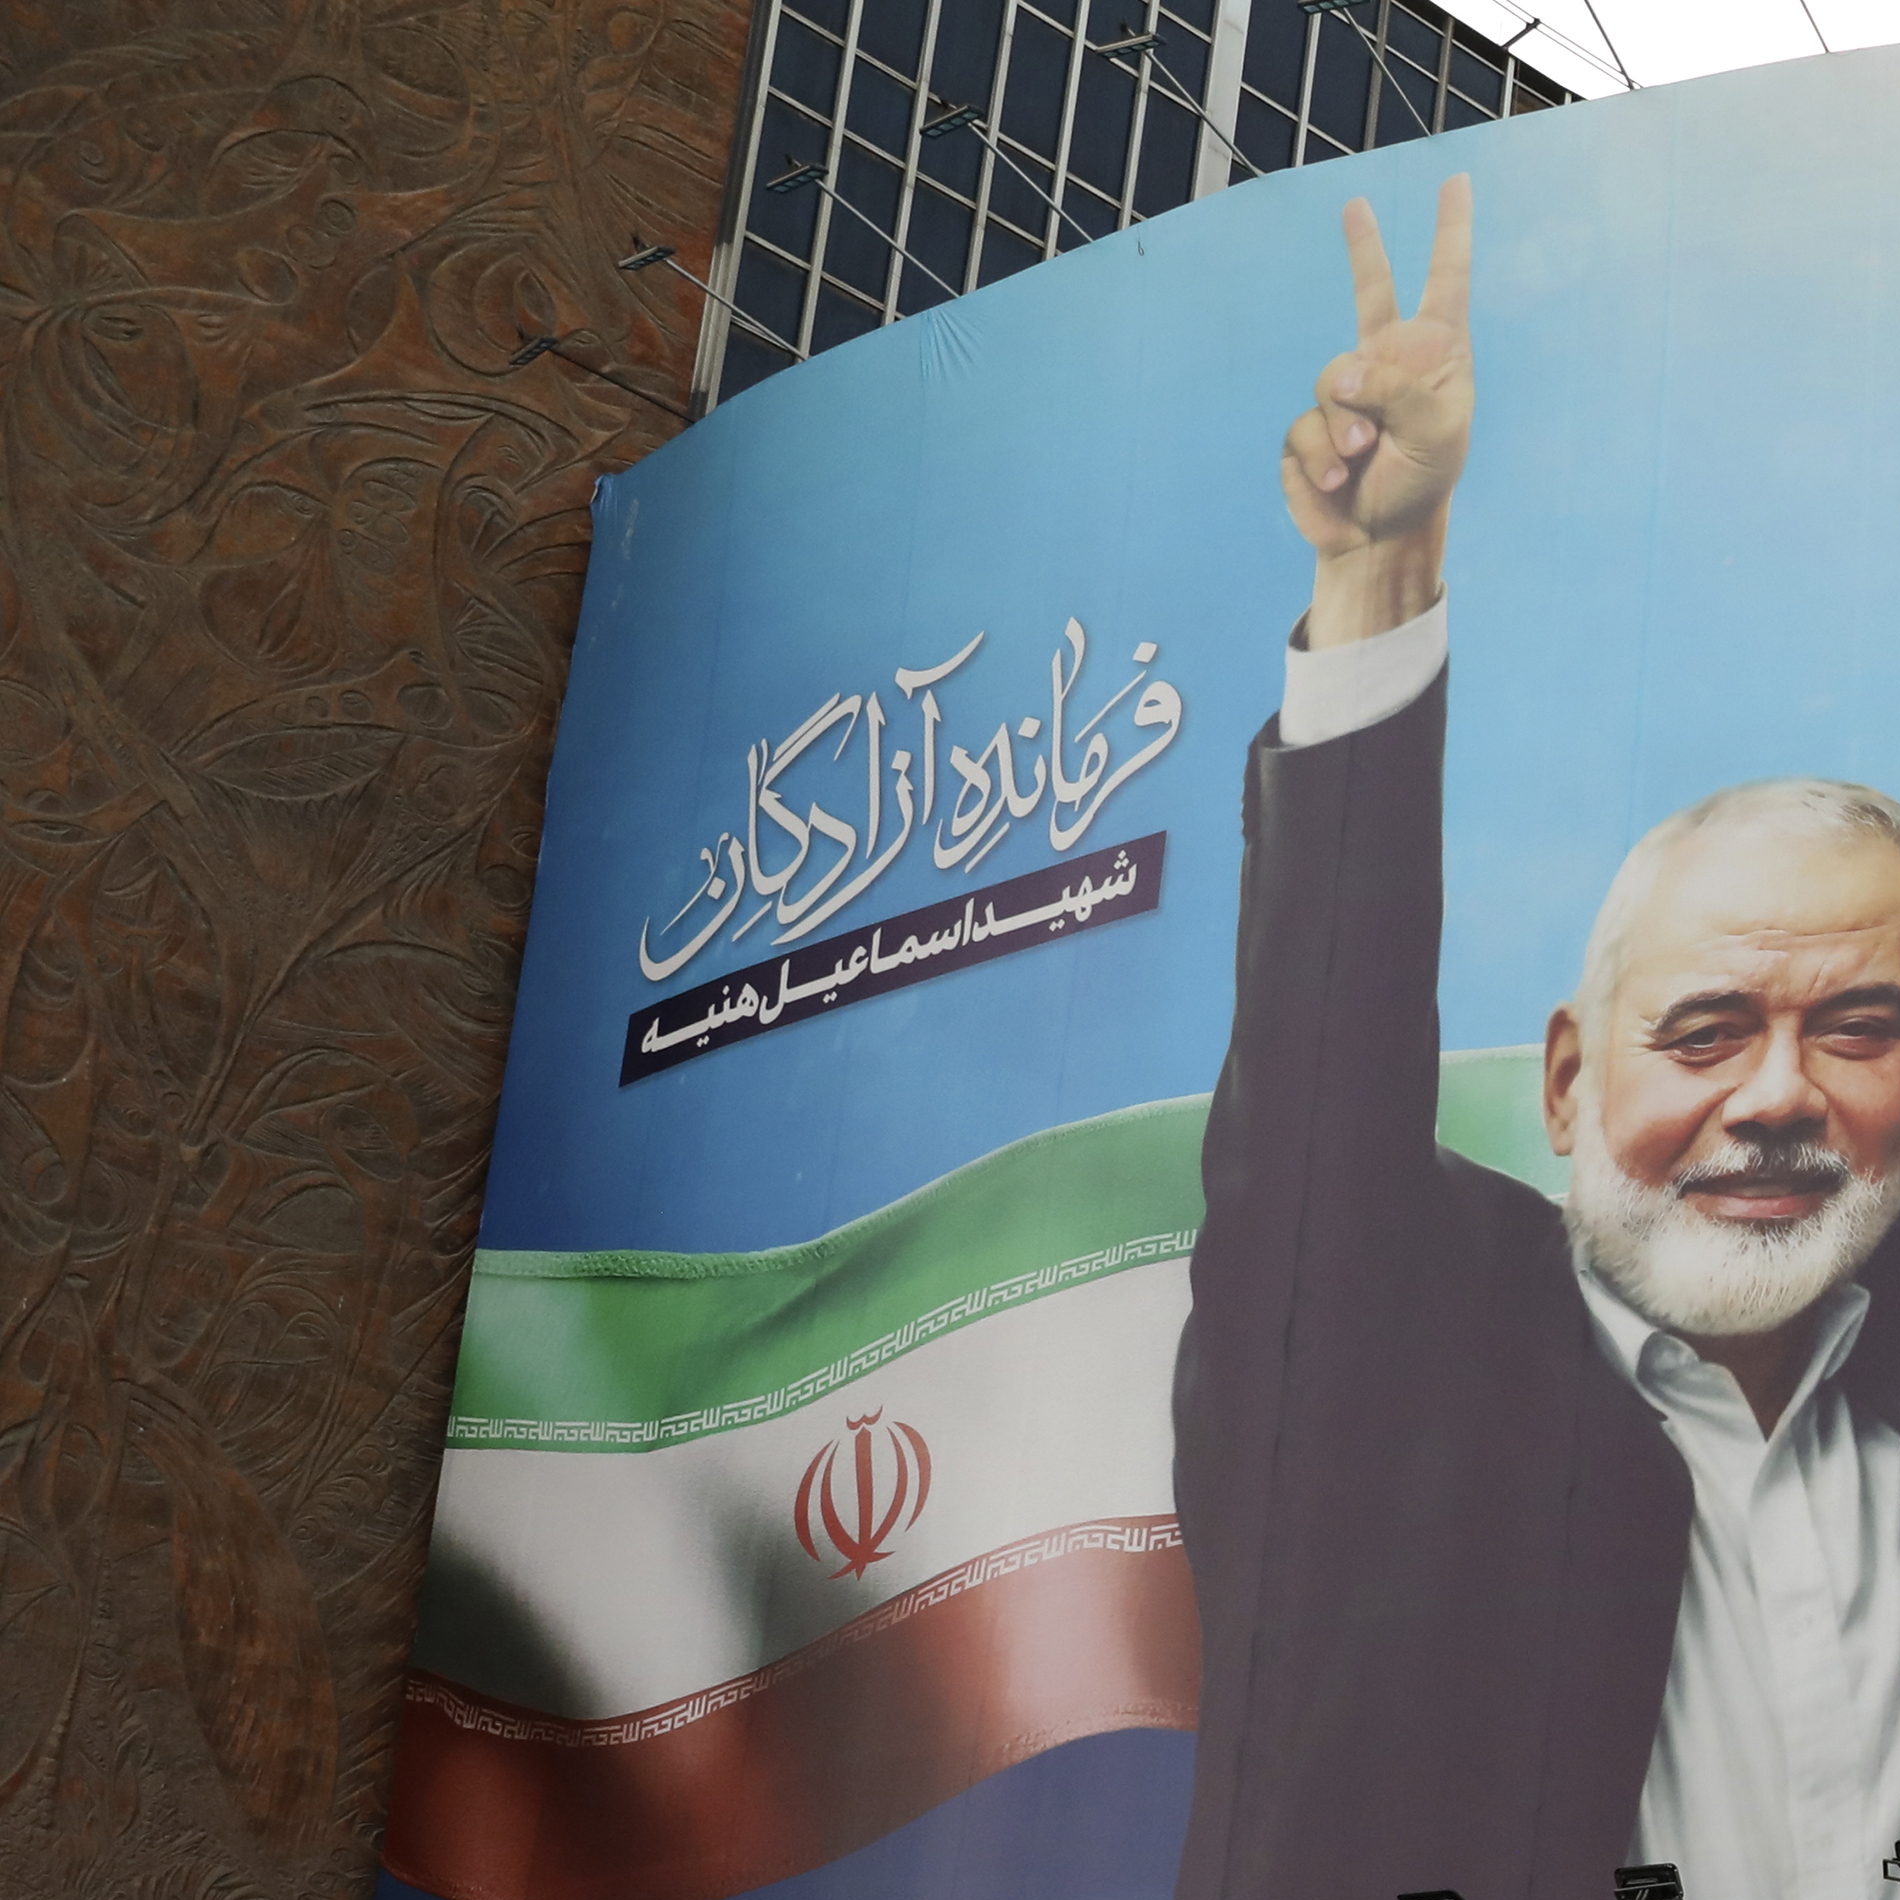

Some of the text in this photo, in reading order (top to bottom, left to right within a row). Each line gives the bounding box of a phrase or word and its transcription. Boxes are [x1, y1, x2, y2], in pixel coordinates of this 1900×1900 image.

[639, 616, 1182, 982] فرمانده آزادگان
[641, 849, 1137, 1054] شهید اسماعیل هنیه
